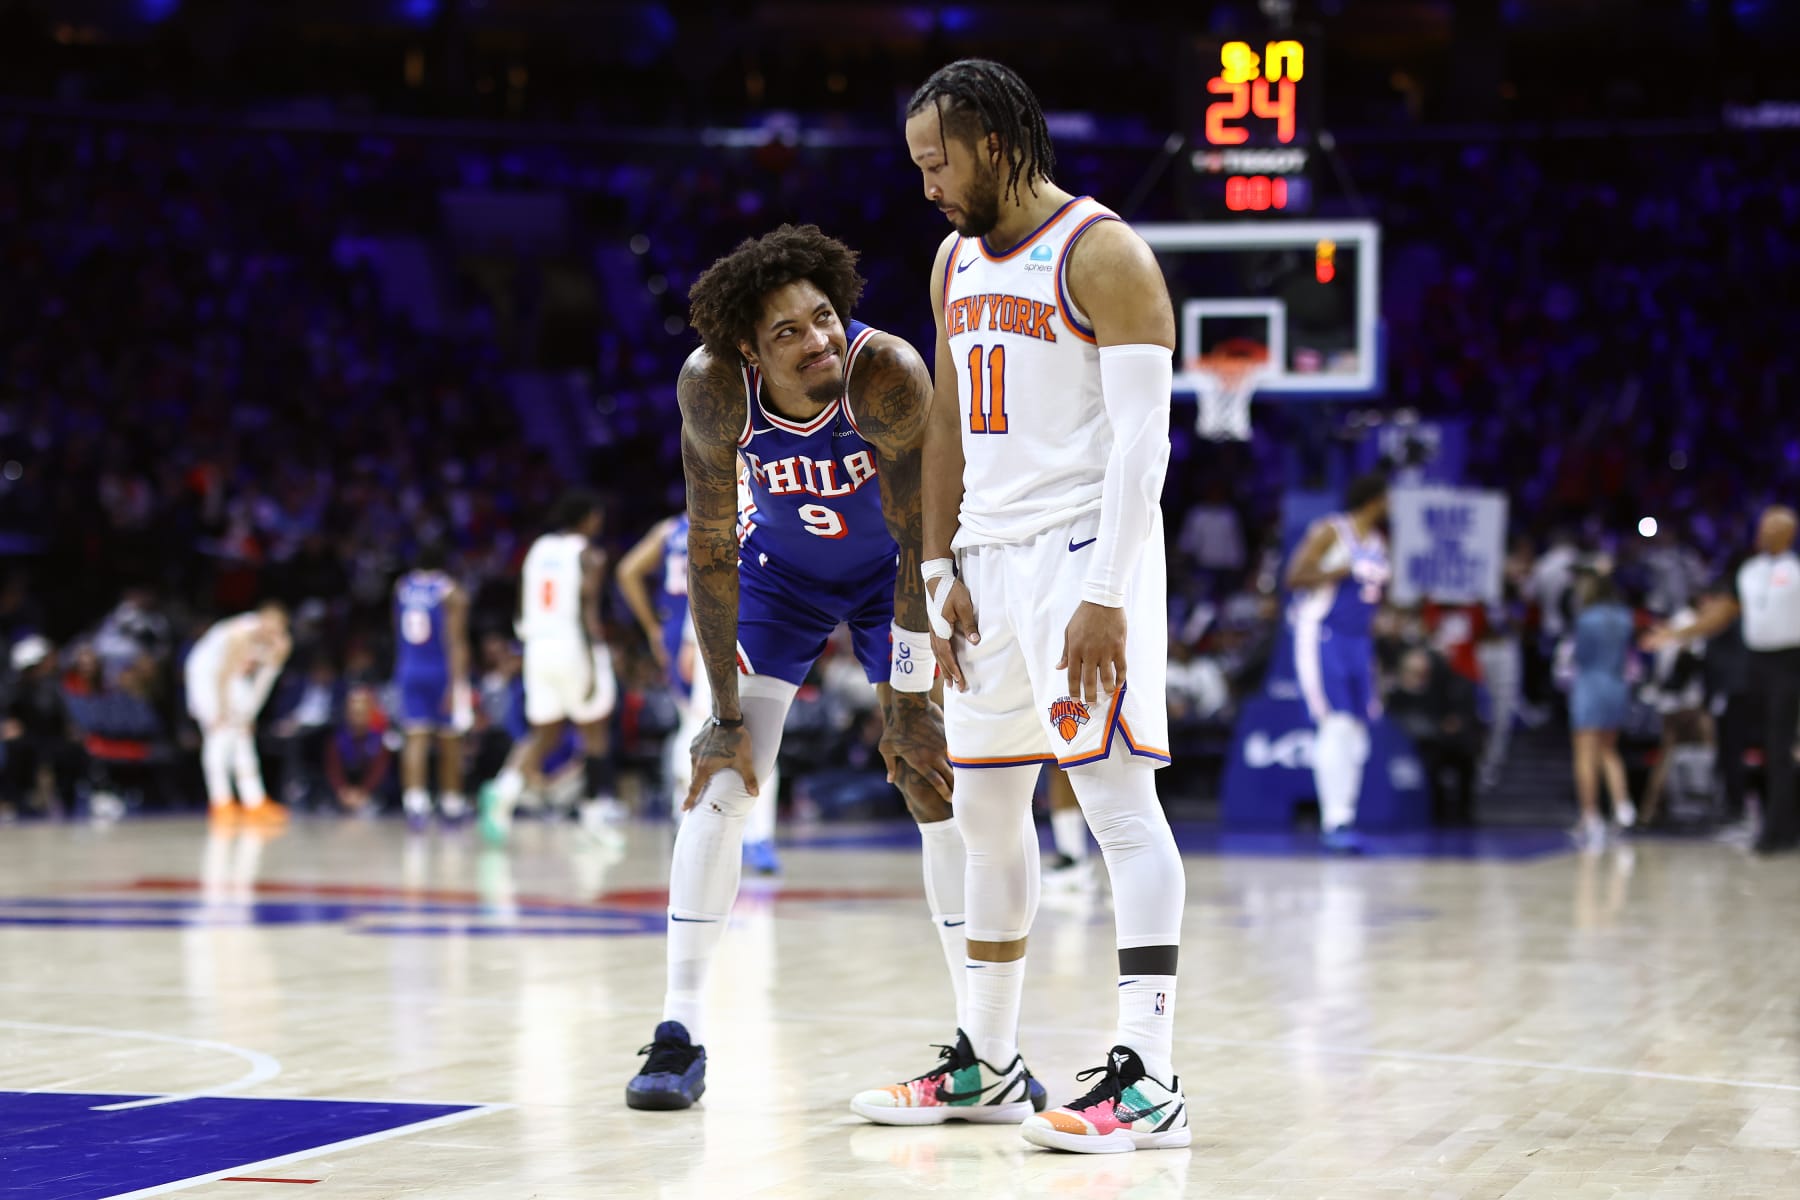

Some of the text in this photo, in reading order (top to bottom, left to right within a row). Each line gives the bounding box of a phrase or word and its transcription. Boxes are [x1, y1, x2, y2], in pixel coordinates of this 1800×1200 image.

[1205, 76, 1296, 145] 24
[1024, 263, 1054, 272] sphere
[946, 292, 1057, 343] NEW YORK
[968, 344, 1008, 434] 11
[746, 450, 876, 498] PHILA
[798, 503, 848, 540] 9
[1050, 700, 1091, 722] KNICKS
